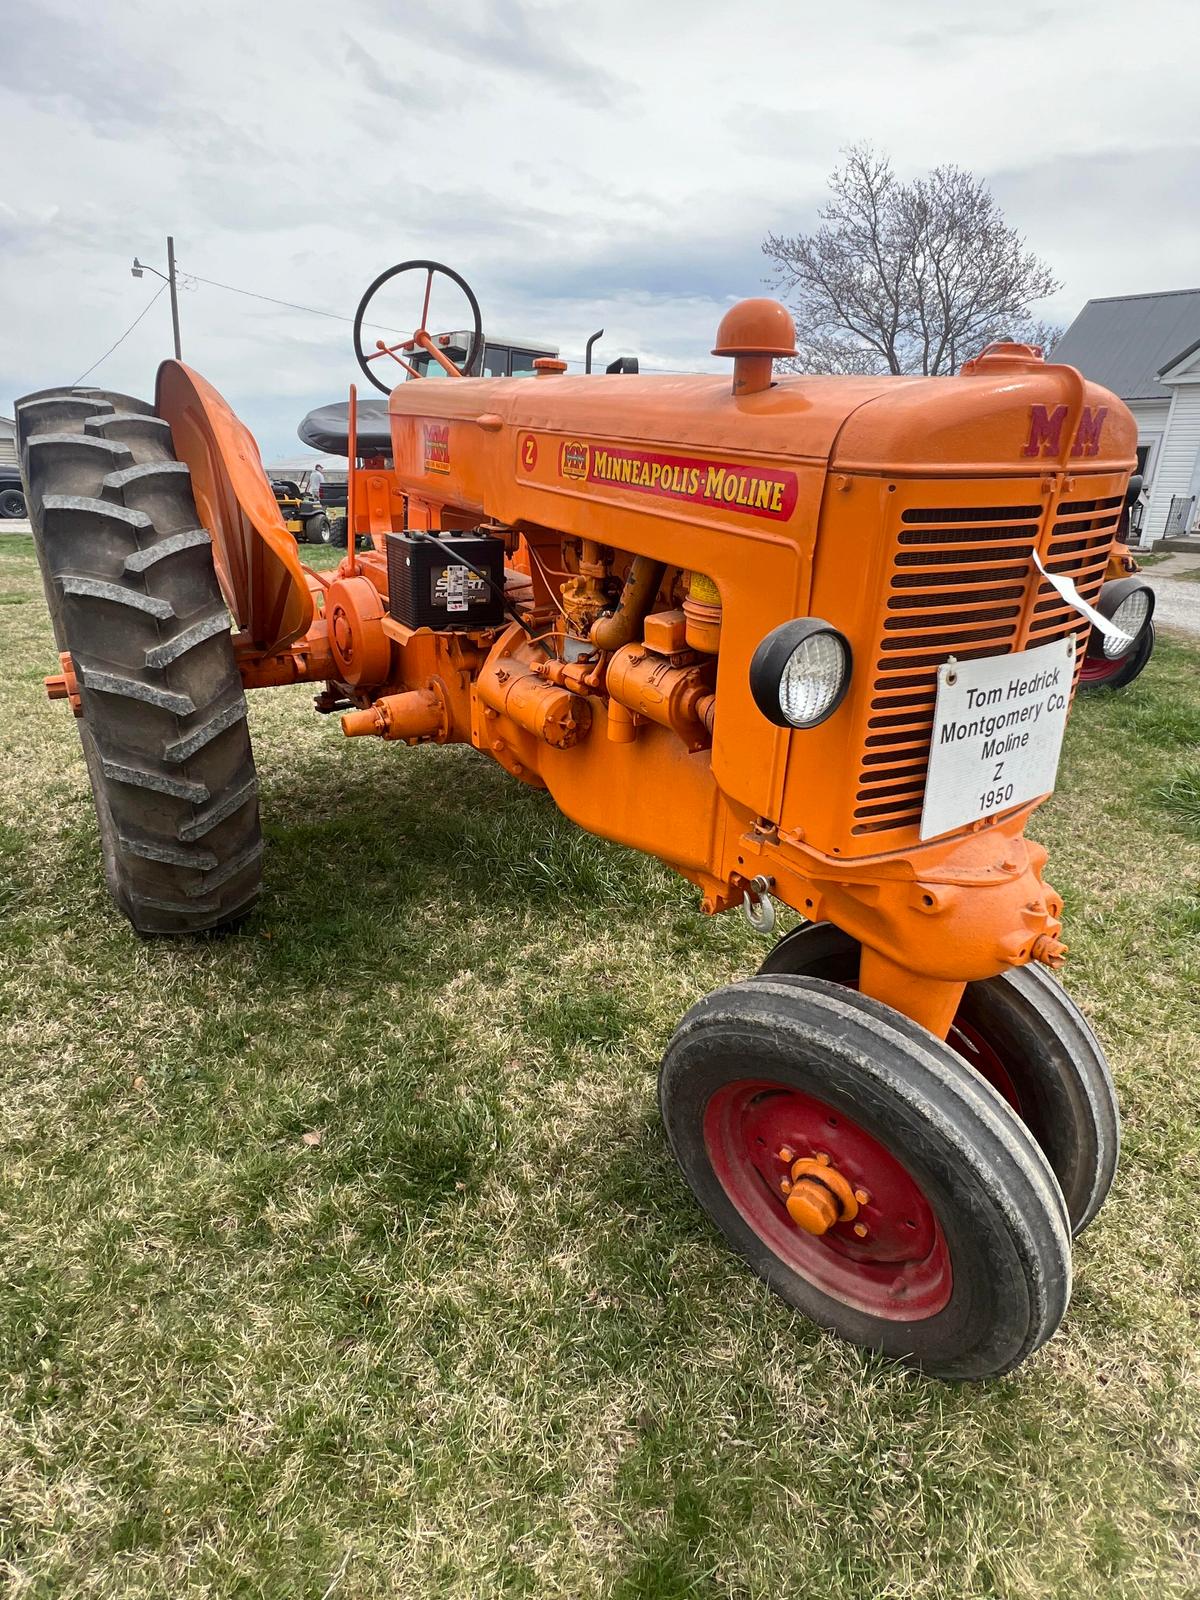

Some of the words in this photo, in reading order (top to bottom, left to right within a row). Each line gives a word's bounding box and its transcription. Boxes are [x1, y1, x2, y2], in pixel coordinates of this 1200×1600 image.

[525, 440, 534, 465] Z
[966, 688, 1003, 710] Tom
[1007, 667, 1060, 701] Hedrick
[940, 701, 1044, 745] Montgomery
[1047, 693, 1066, 713] Co.
[981, 732, 1030, 760] Moline
[992, 761, 1005, 782] Z
[979, 783, 1014, 811] 1950
